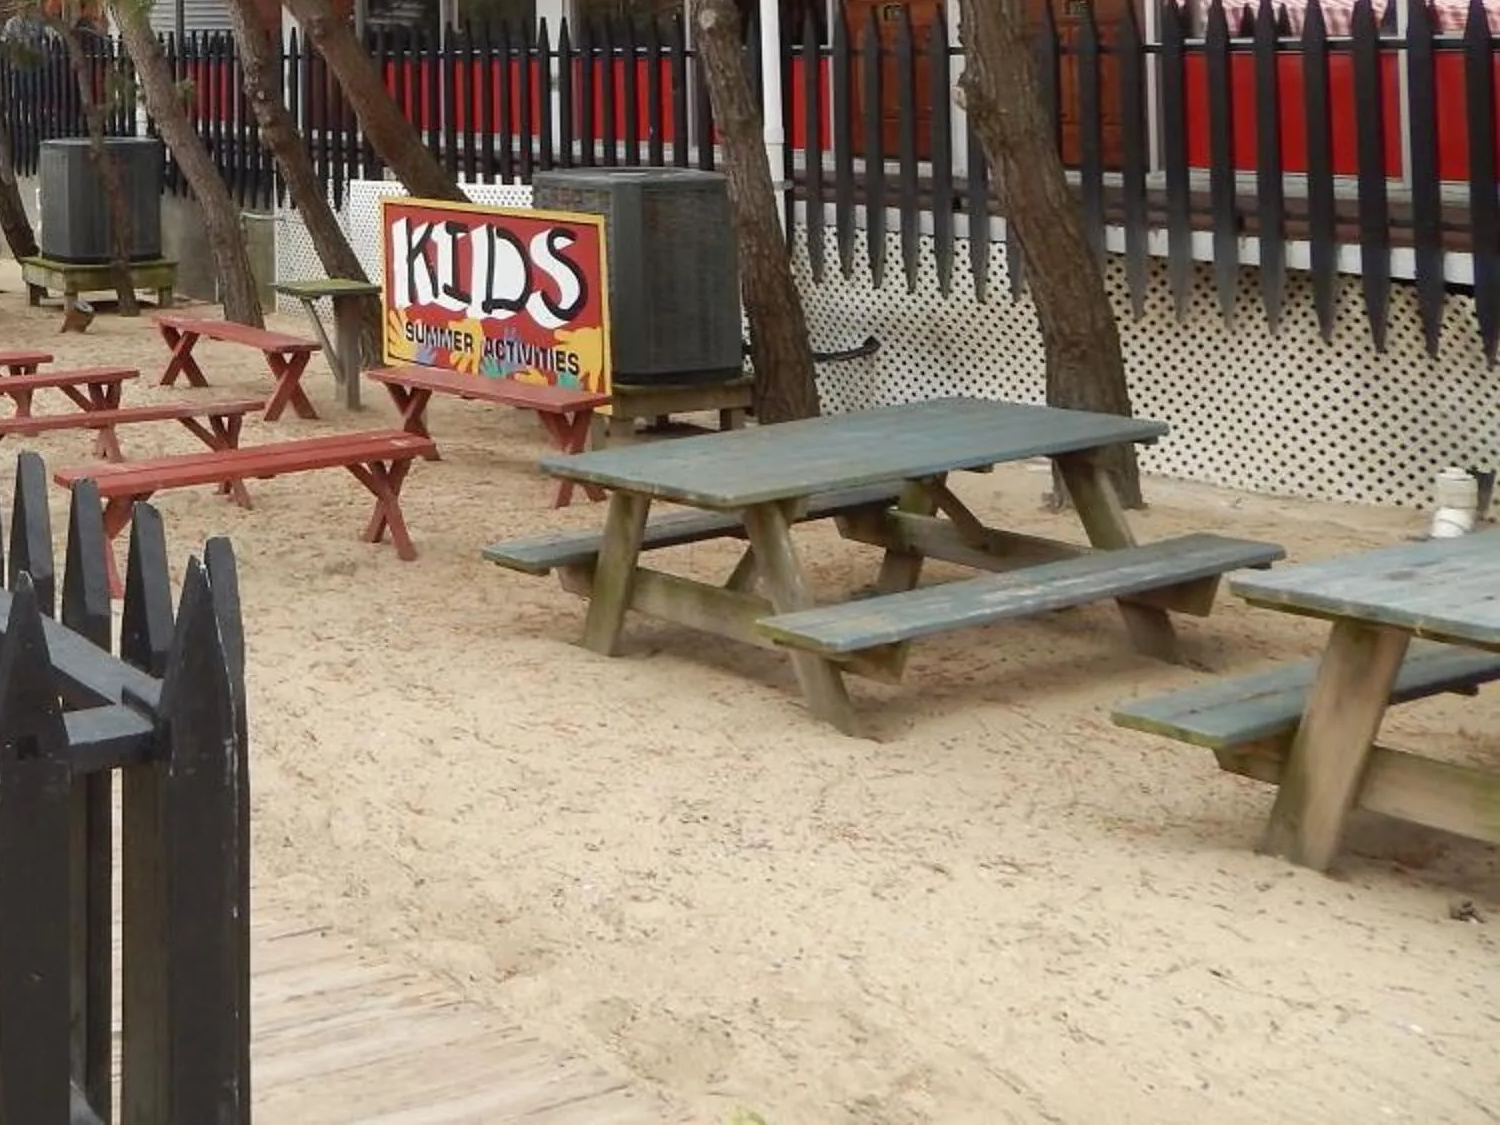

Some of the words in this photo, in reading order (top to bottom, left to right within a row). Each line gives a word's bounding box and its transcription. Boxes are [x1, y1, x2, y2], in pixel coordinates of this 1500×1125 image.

[392, 217, 588, 329] KIDS
[405, 321, 474, 353] SUMMER
[483, 337, 580, 376] ACTIVITIES
